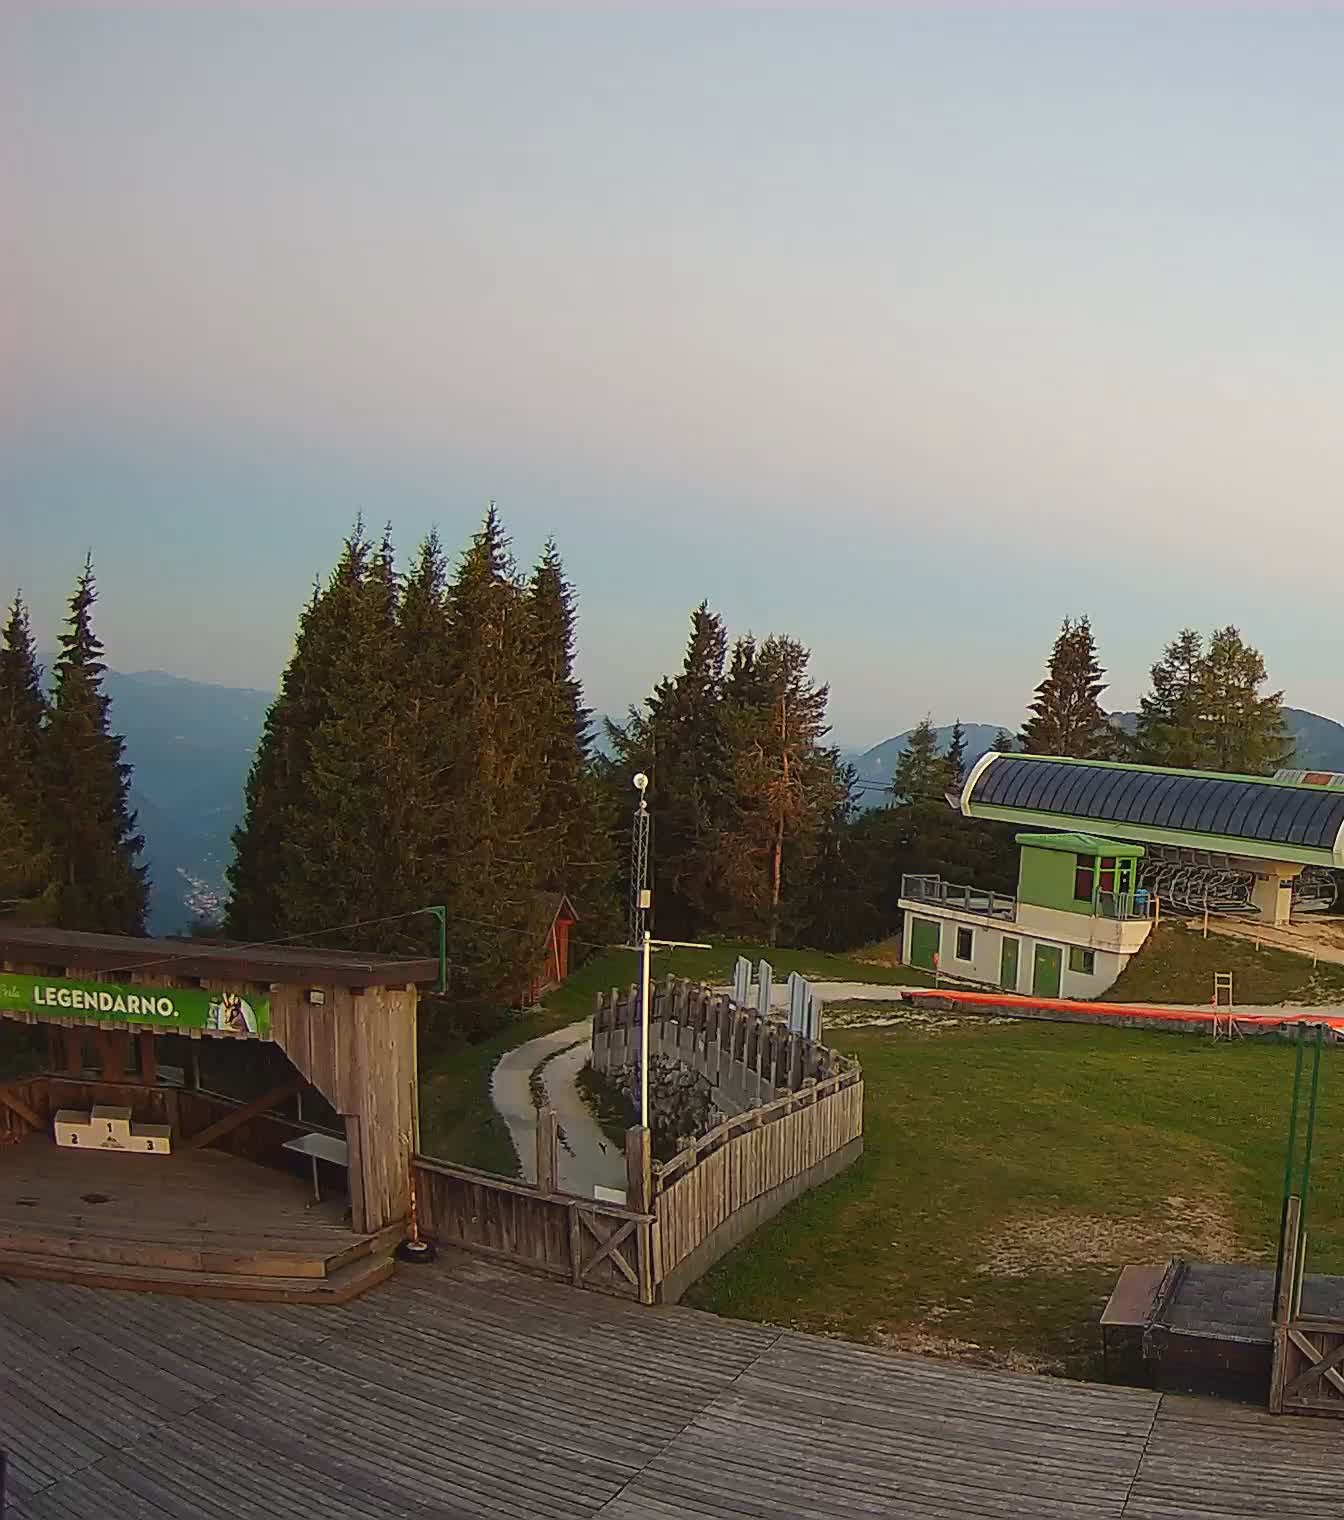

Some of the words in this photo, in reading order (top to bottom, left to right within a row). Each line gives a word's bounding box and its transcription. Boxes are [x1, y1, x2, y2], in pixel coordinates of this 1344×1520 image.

[34, 985, 180, 1017] LEGENDARNO.
[106, 1122, 113, 1133] 1
[71, 1133, 79, 1145] 2
[146, 1140, 154, 1151] 3
